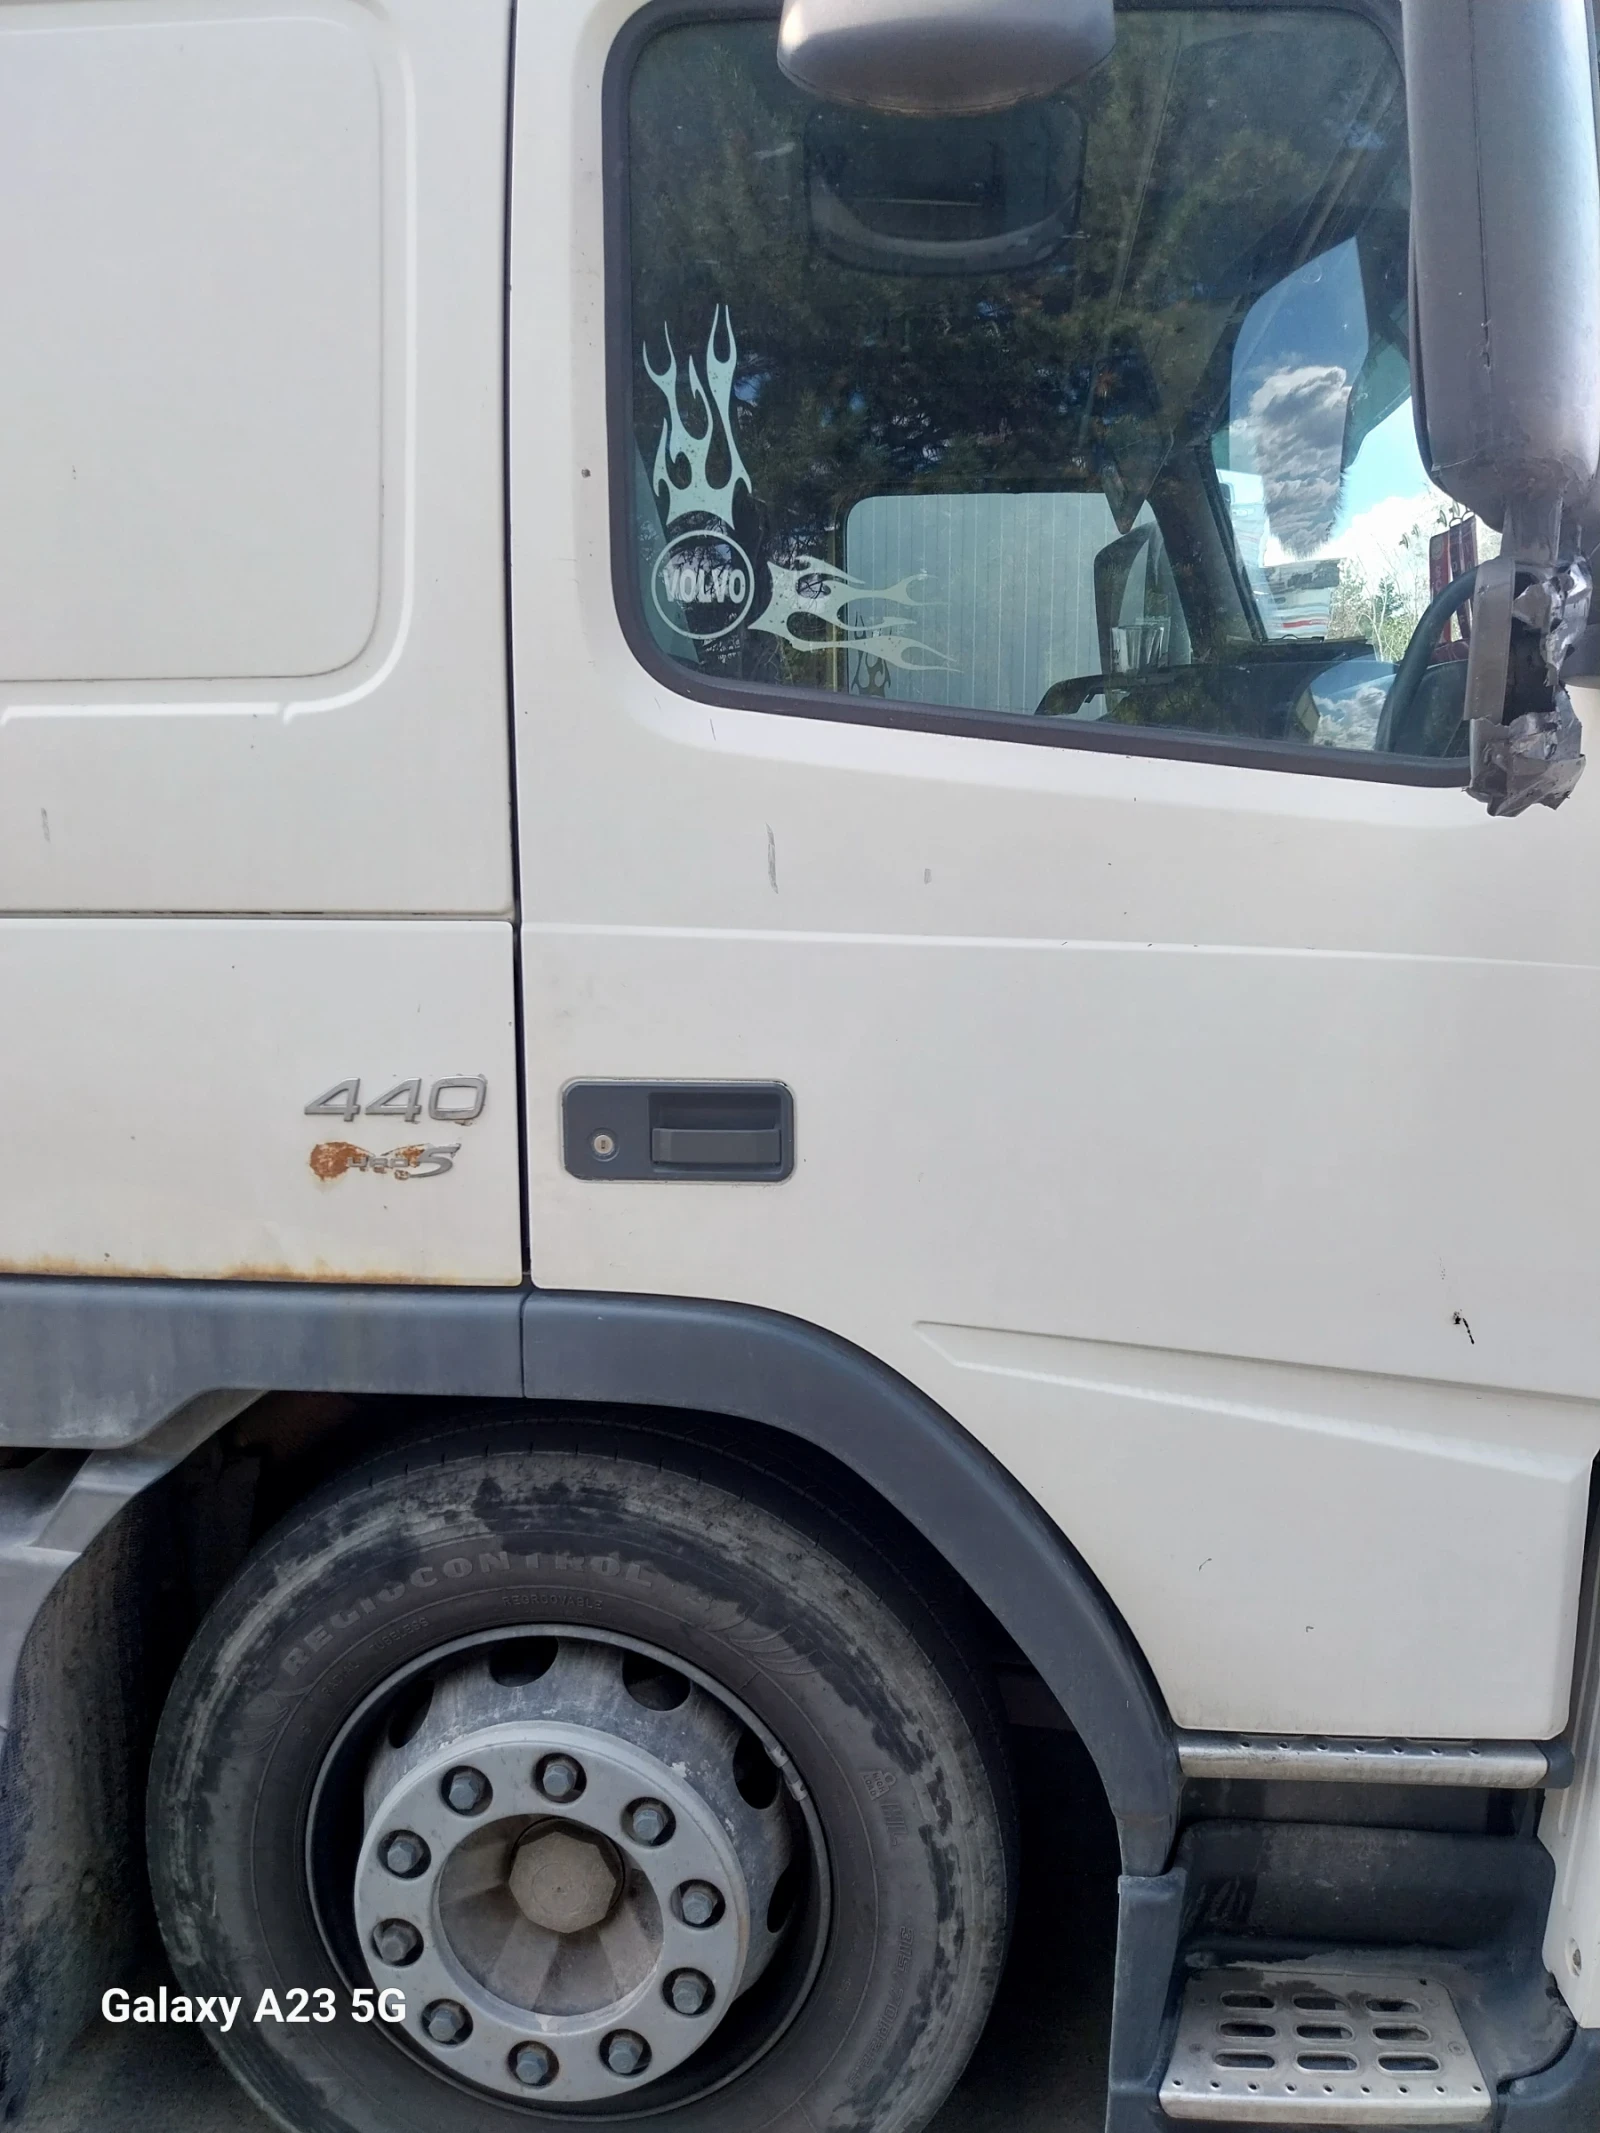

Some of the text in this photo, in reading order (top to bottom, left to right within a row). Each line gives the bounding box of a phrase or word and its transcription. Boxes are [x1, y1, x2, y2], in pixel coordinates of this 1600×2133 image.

[664, 568, 746, 604] VOLVO
[304, 1077, 487, 1122] 440
[863, 1774, 876, 1796] LOAD
[872, 1772, 885, 1793] HIGH
